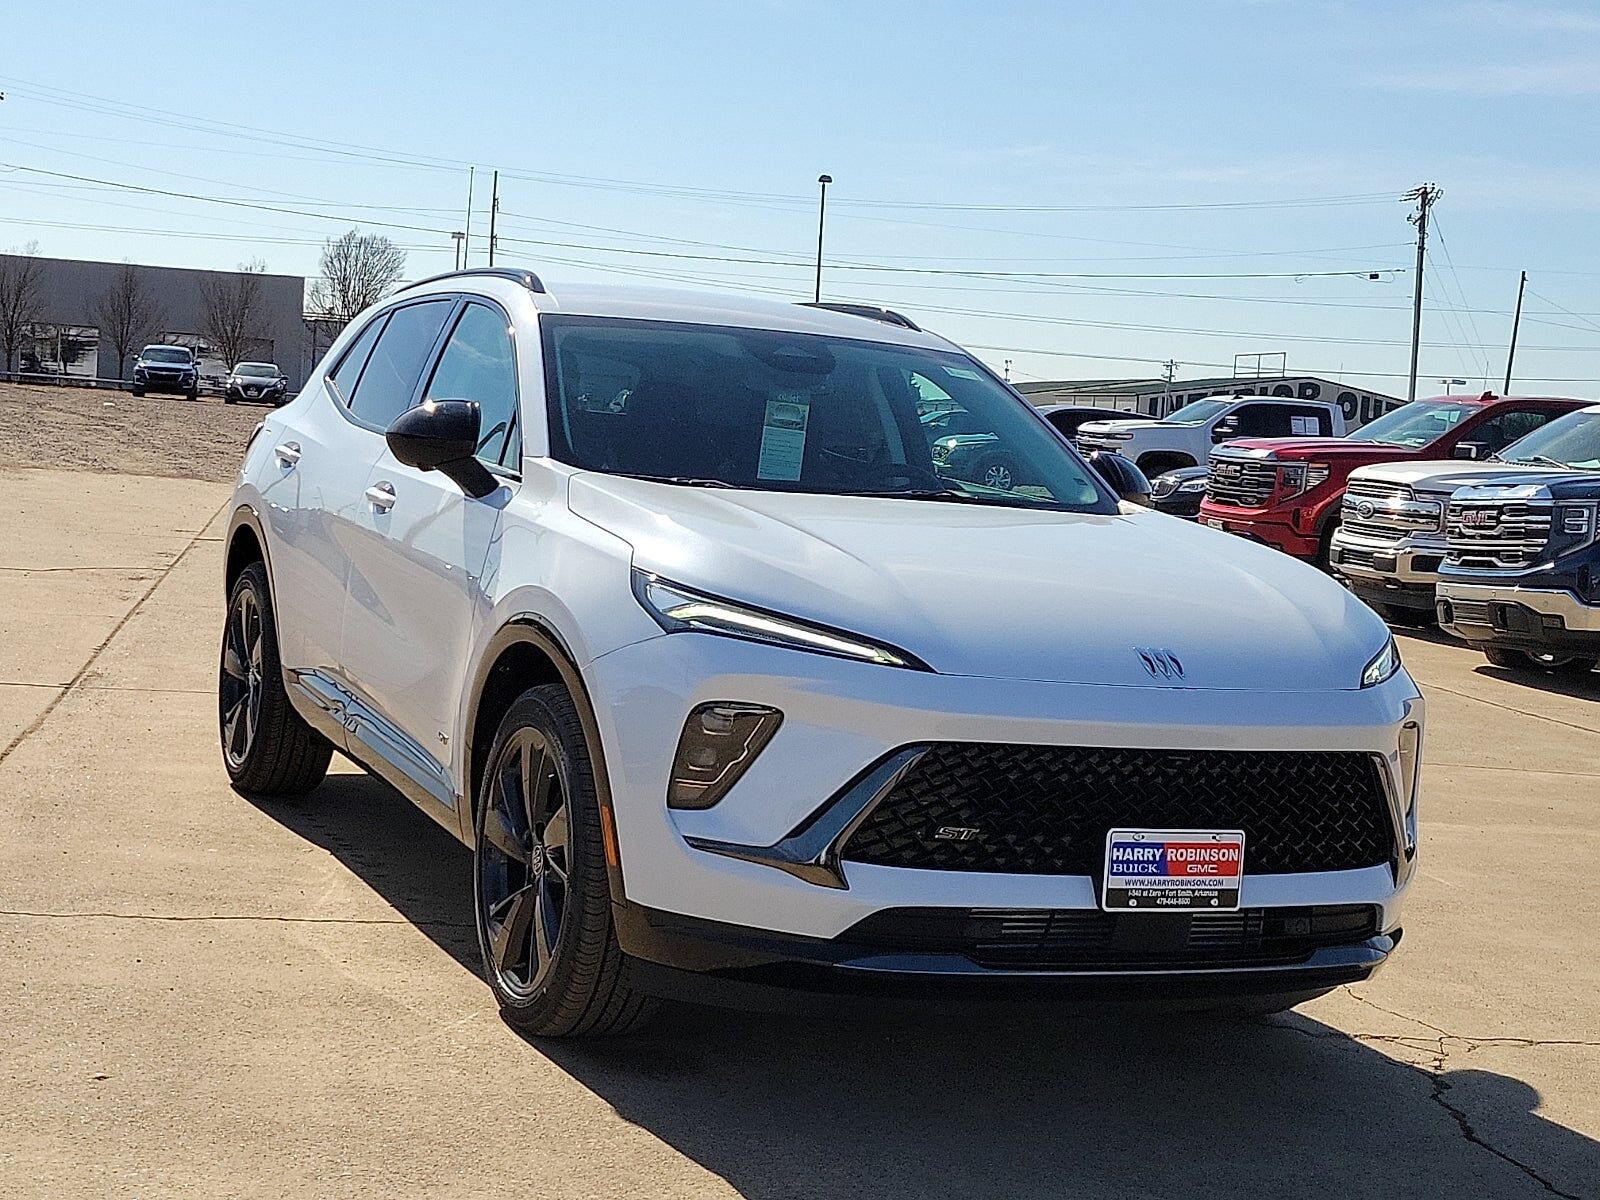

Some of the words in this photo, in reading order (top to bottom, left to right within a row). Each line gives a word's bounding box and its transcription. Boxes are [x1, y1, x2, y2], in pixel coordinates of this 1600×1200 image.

[1461, 510, 1498, 526] GMC
[934, 826, 980, 840] ST
[1112, 847, 1164, 861] HARRY
[1166, 848, 1239, 862] ROBINSON
[1186, 864, 1219, 873] GMC
[1124, 878, 1224, 887] WWW.HARRYROBINSON.COM
[1165, 889, 1177, 897] Fort
